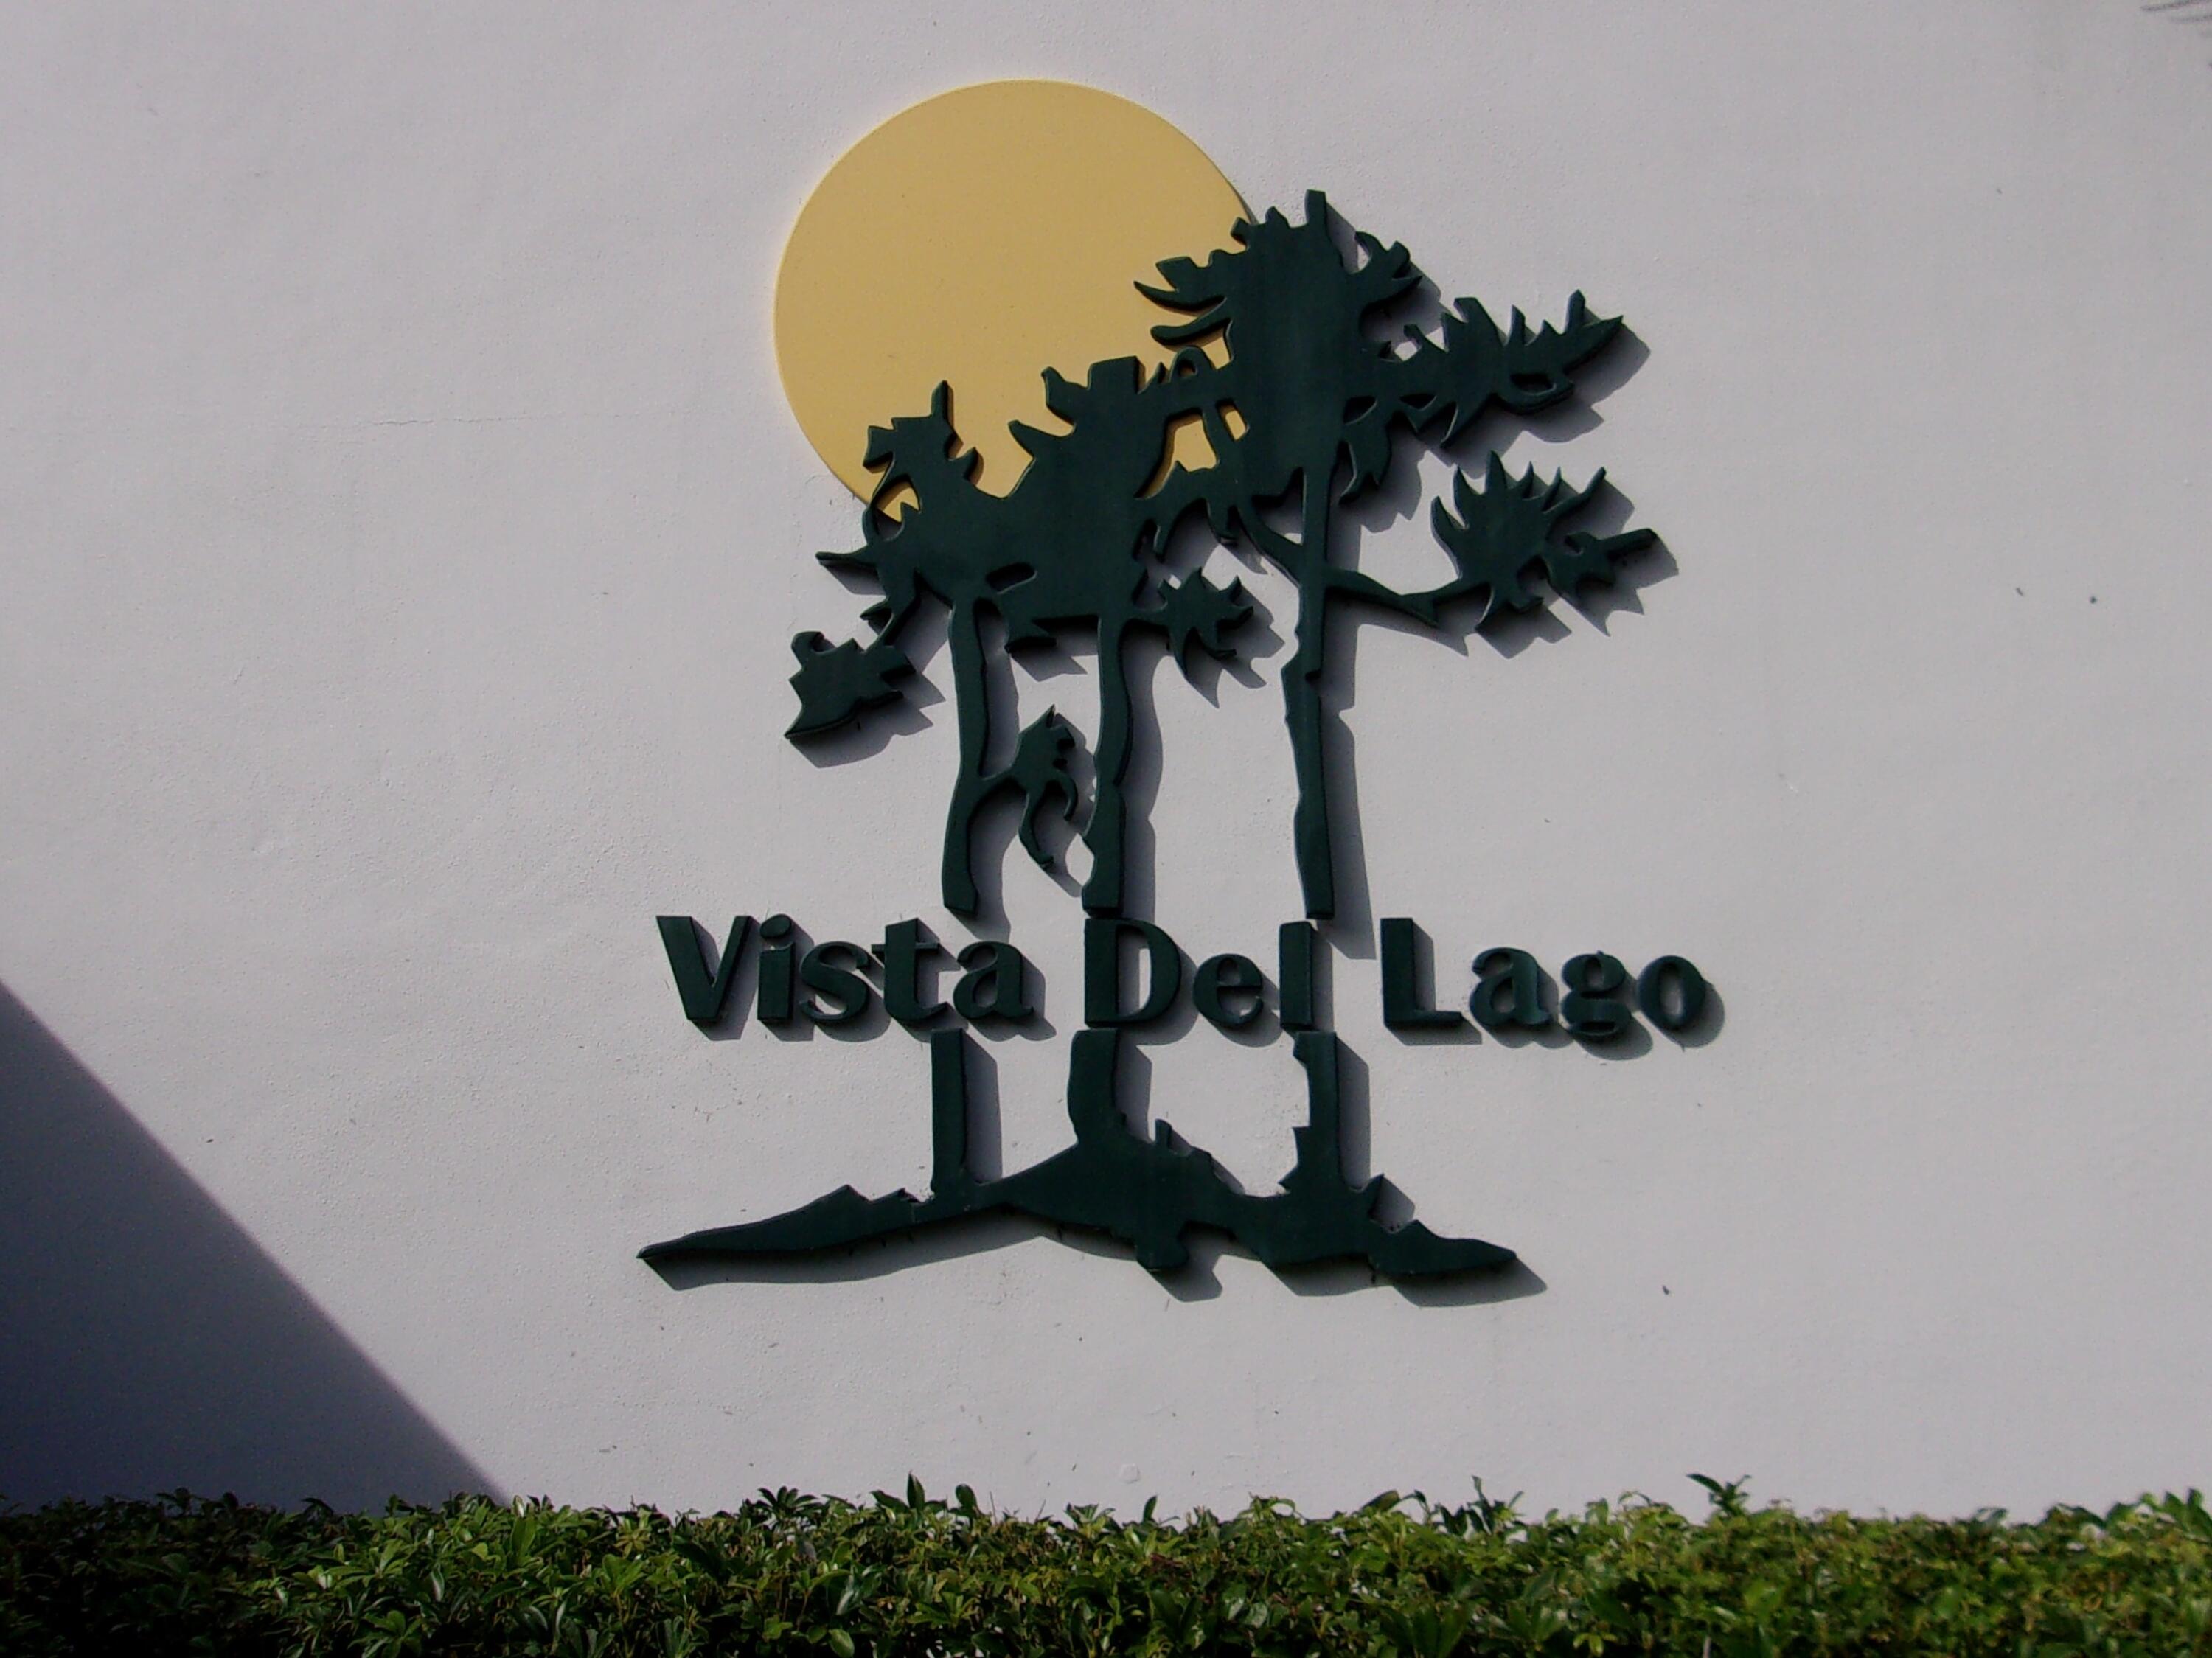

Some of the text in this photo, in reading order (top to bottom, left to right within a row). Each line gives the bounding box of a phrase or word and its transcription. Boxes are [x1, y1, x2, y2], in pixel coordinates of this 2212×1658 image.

[657, 914, 1705, 1039] Vista Del Lago
